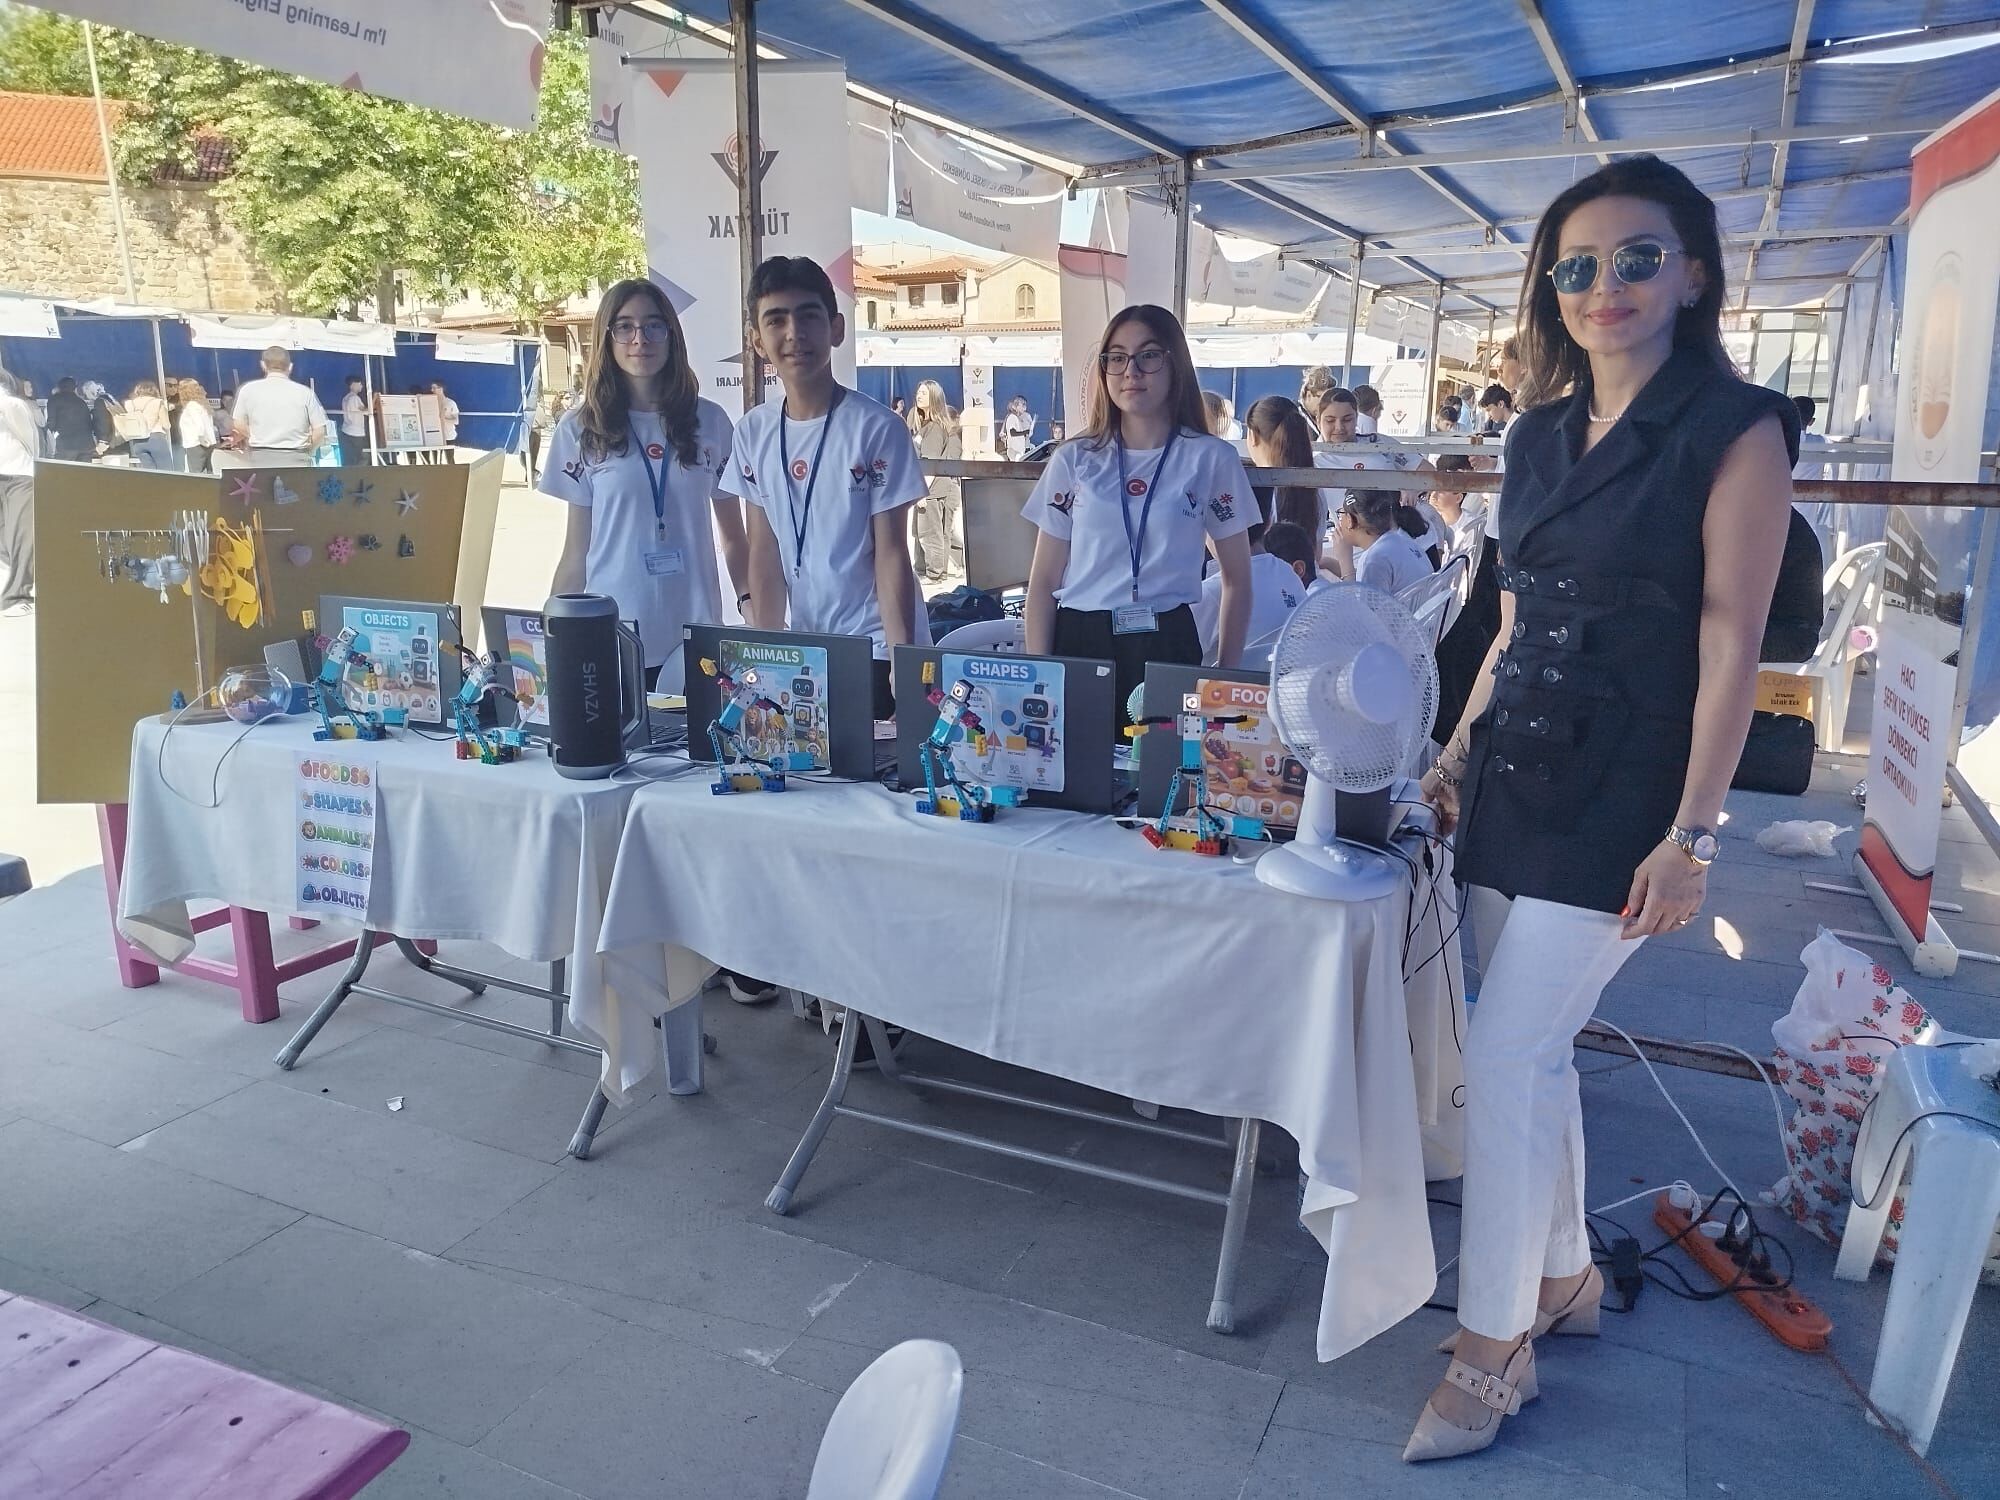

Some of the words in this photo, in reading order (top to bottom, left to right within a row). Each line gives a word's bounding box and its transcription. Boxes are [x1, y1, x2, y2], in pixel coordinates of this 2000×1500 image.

[364, 613, 409, 627] OBJECTS
[742, 647, 800, 663] ANIMALS
[970, 661, 1029, 679] SHAPES
[1900, 663, 1916, 692] HACI
[583, 661, 600, 723] VZVHS
[1898, 698, 1906, 721] VE
[1906, 703, 1930, 742] YÜKSEL
[1887, 724, 1918, 769] DÖNBEKCİ
[311, 763, 360, 785] FOODS
[1883, 756, 1918, 807] ORTAOKULU
[313, 792, 363, 815] SHAPES
[316, 825, 361, 846] ANIMALS
[319, 855, 365, 878] COLORS
[321, 886, 365, 910] OBJECTS
